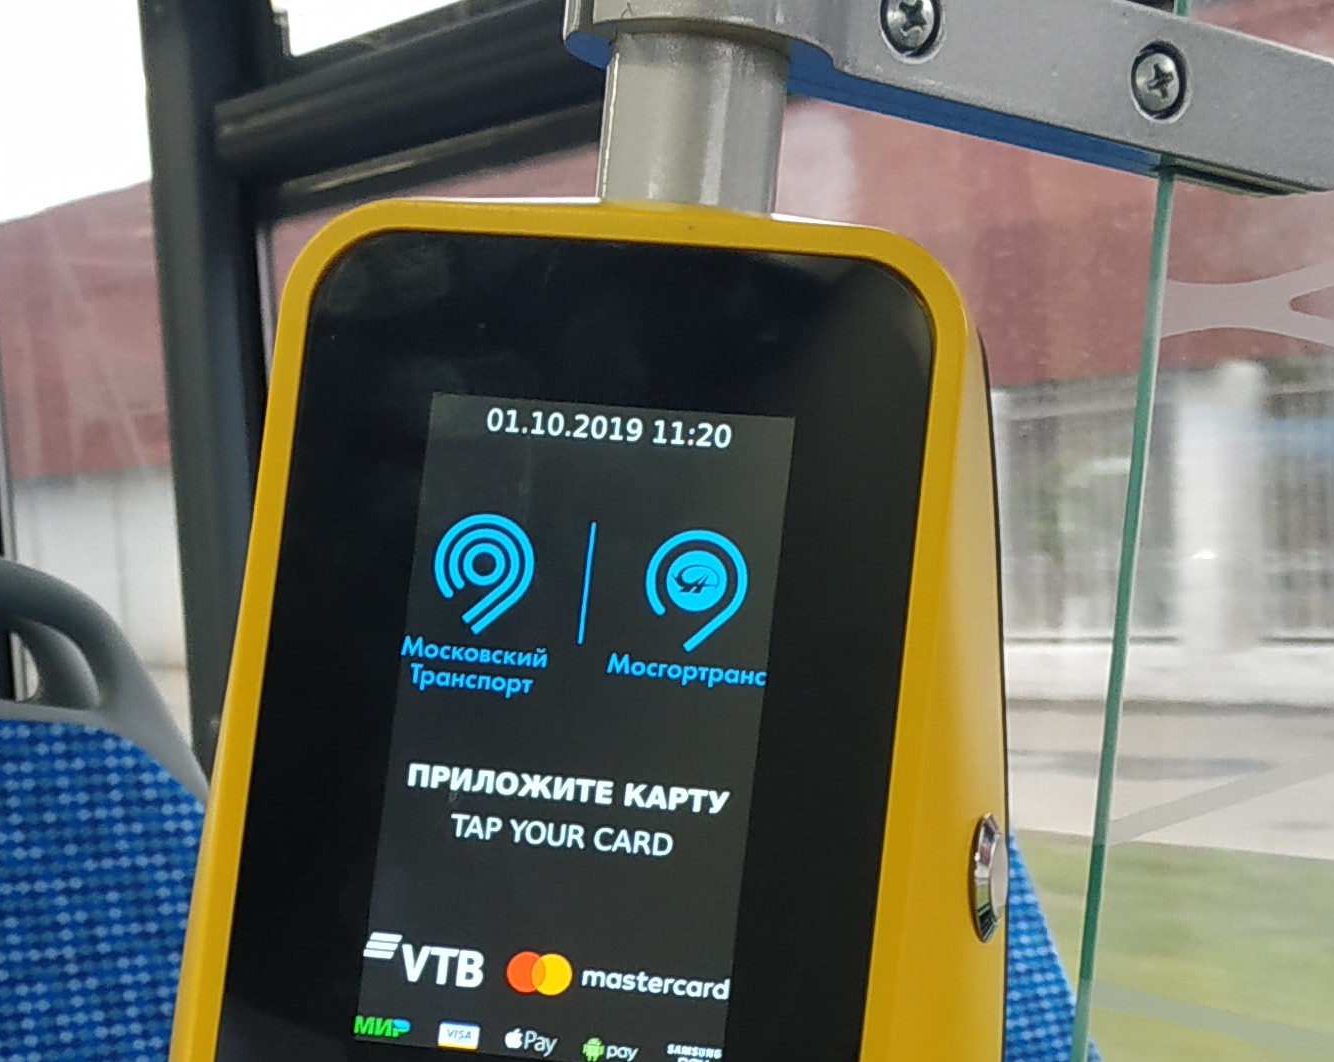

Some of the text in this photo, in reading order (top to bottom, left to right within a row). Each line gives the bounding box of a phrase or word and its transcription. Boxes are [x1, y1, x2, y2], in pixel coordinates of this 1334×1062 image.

[486, 407, 732, 449] 01.10.2019 11:20
[400, 635, 548, 669] Московский
[410, 663, 534, 699] Транспорт
[606, 652, 767, 688] Мосгортранс
[407, 762, 731, 814] ПРИЛОЖИТЕ КАРТУ
[450, 813, 674, 857] TAP YOUR CARD
[401, 943, 485, 988] VTB
[581, 968, 731, 1001] mastercard
[353, 1015, 411, 1038] МИР
[447, 1028, 472, 1040] VISA
[523, 1030, 558, 1057] Pay
[605, 1045, 639, 1062] pay
[667, 1043, 723, 1059] SAMSUNG
